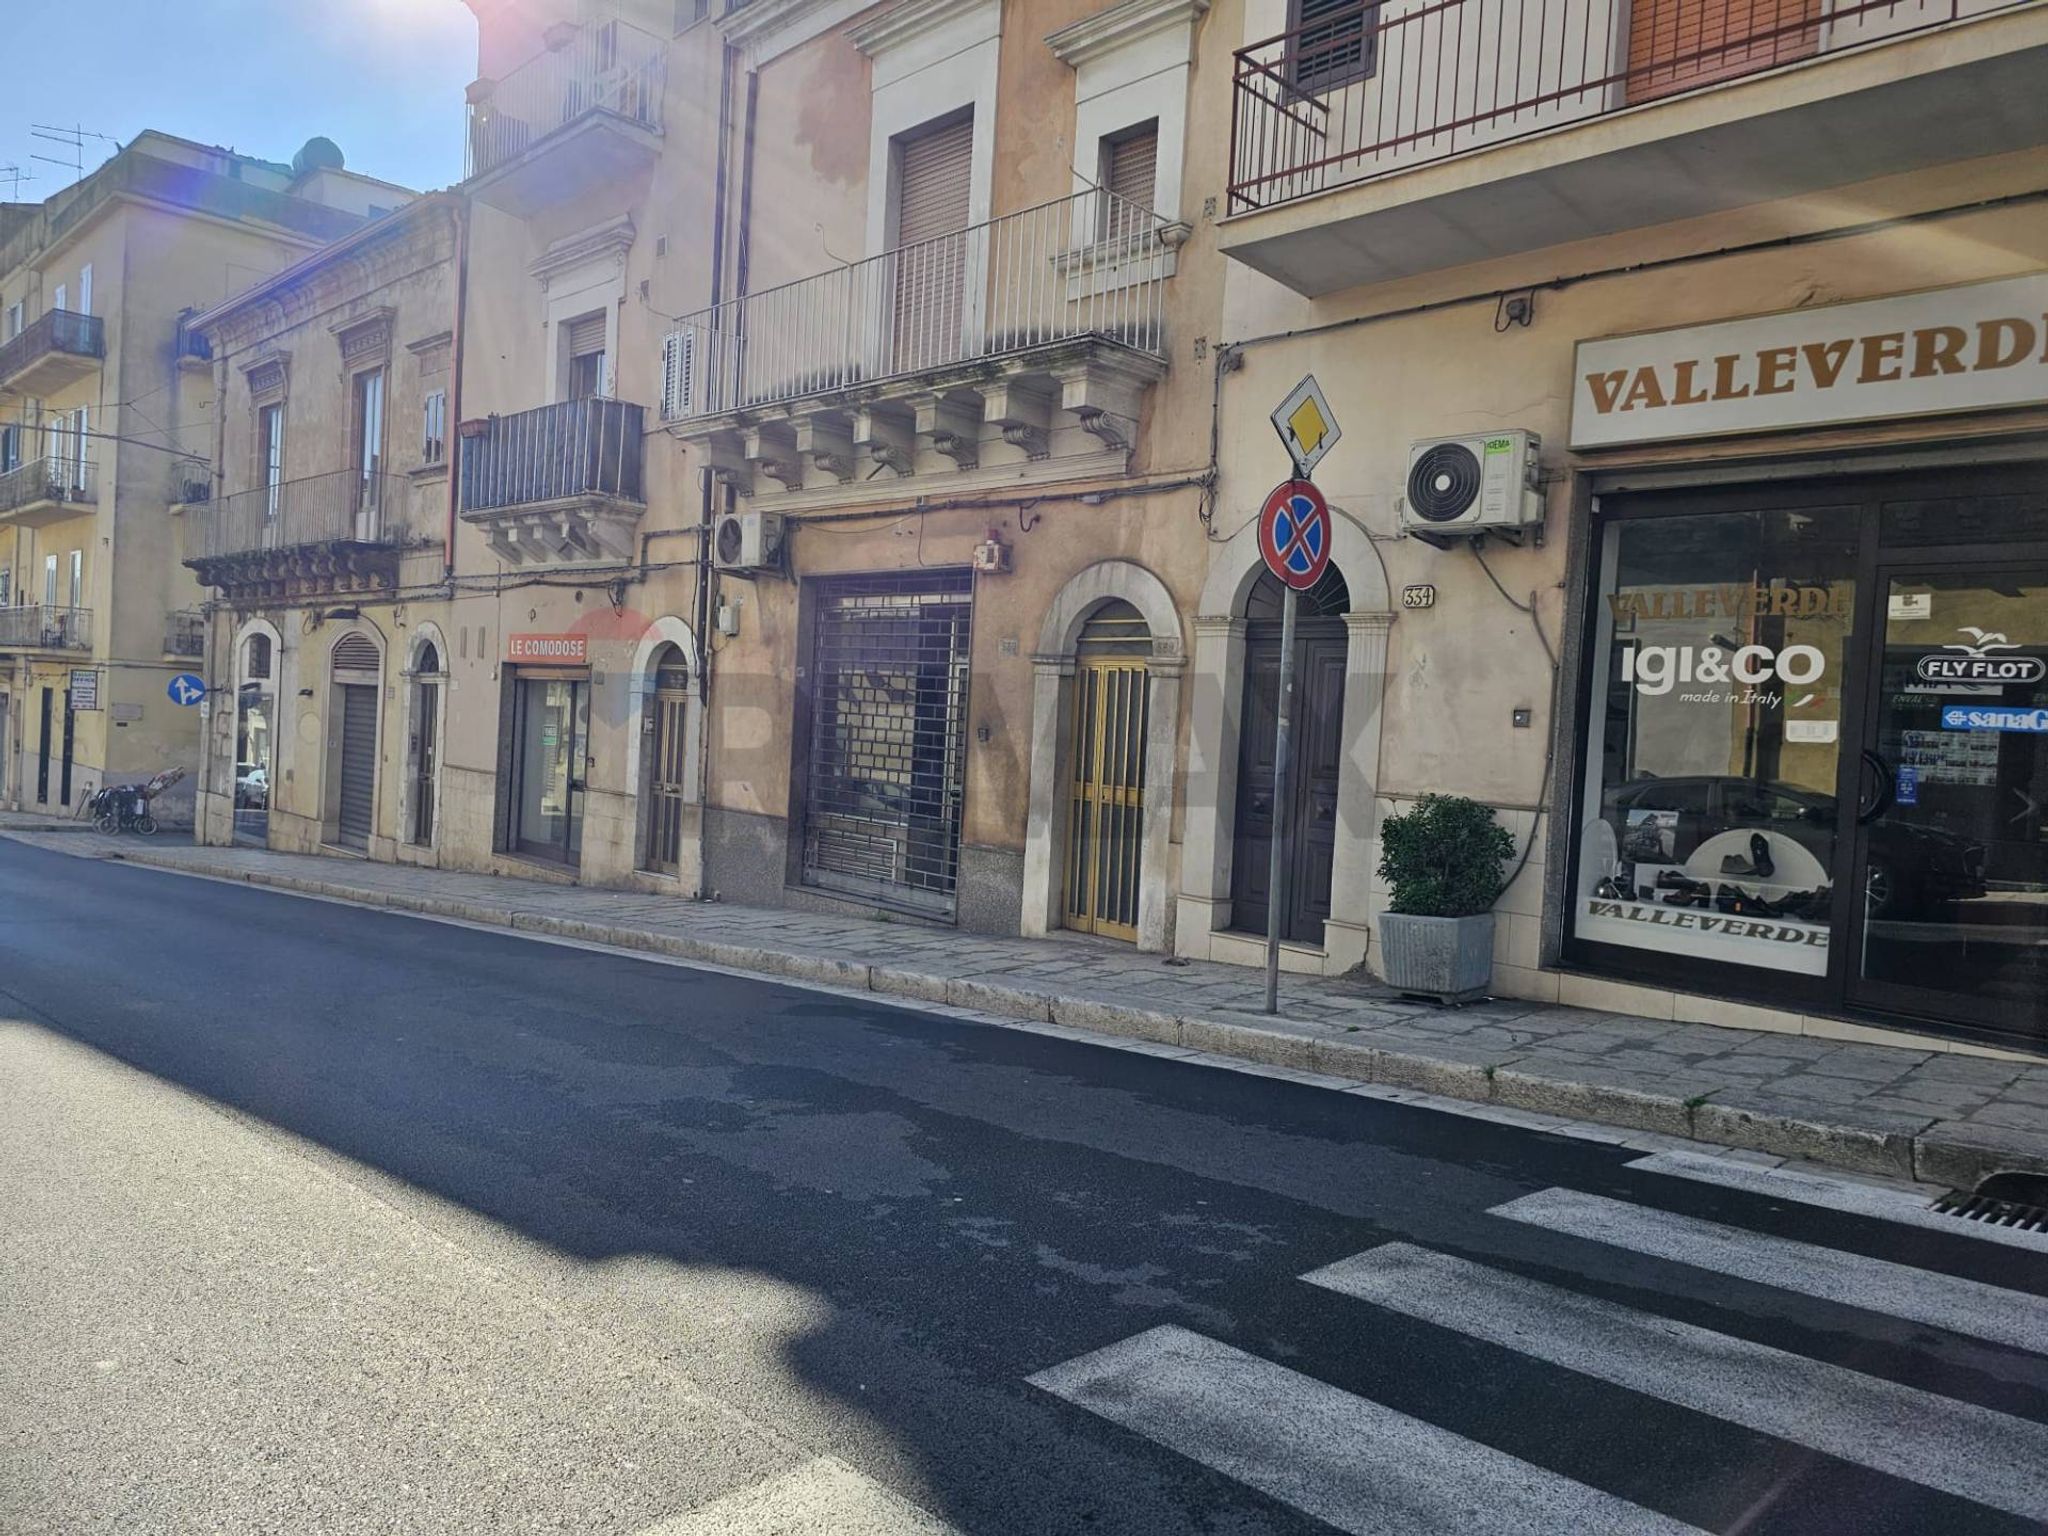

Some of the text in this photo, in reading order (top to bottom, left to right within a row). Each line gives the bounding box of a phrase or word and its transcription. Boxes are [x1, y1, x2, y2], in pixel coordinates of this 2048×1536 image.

[1585, 311, 2048, 415] VALLEVERD
[1405, 587, 1431, 606] 334
[510, 639, 584, 656] LE COMODOSE
[1927, 661, 2034, 679] FLY FLOT
[1679, 689, 1783, 710] made in Italy
[1588, 900, 1831, 948] VALLEVERDE
